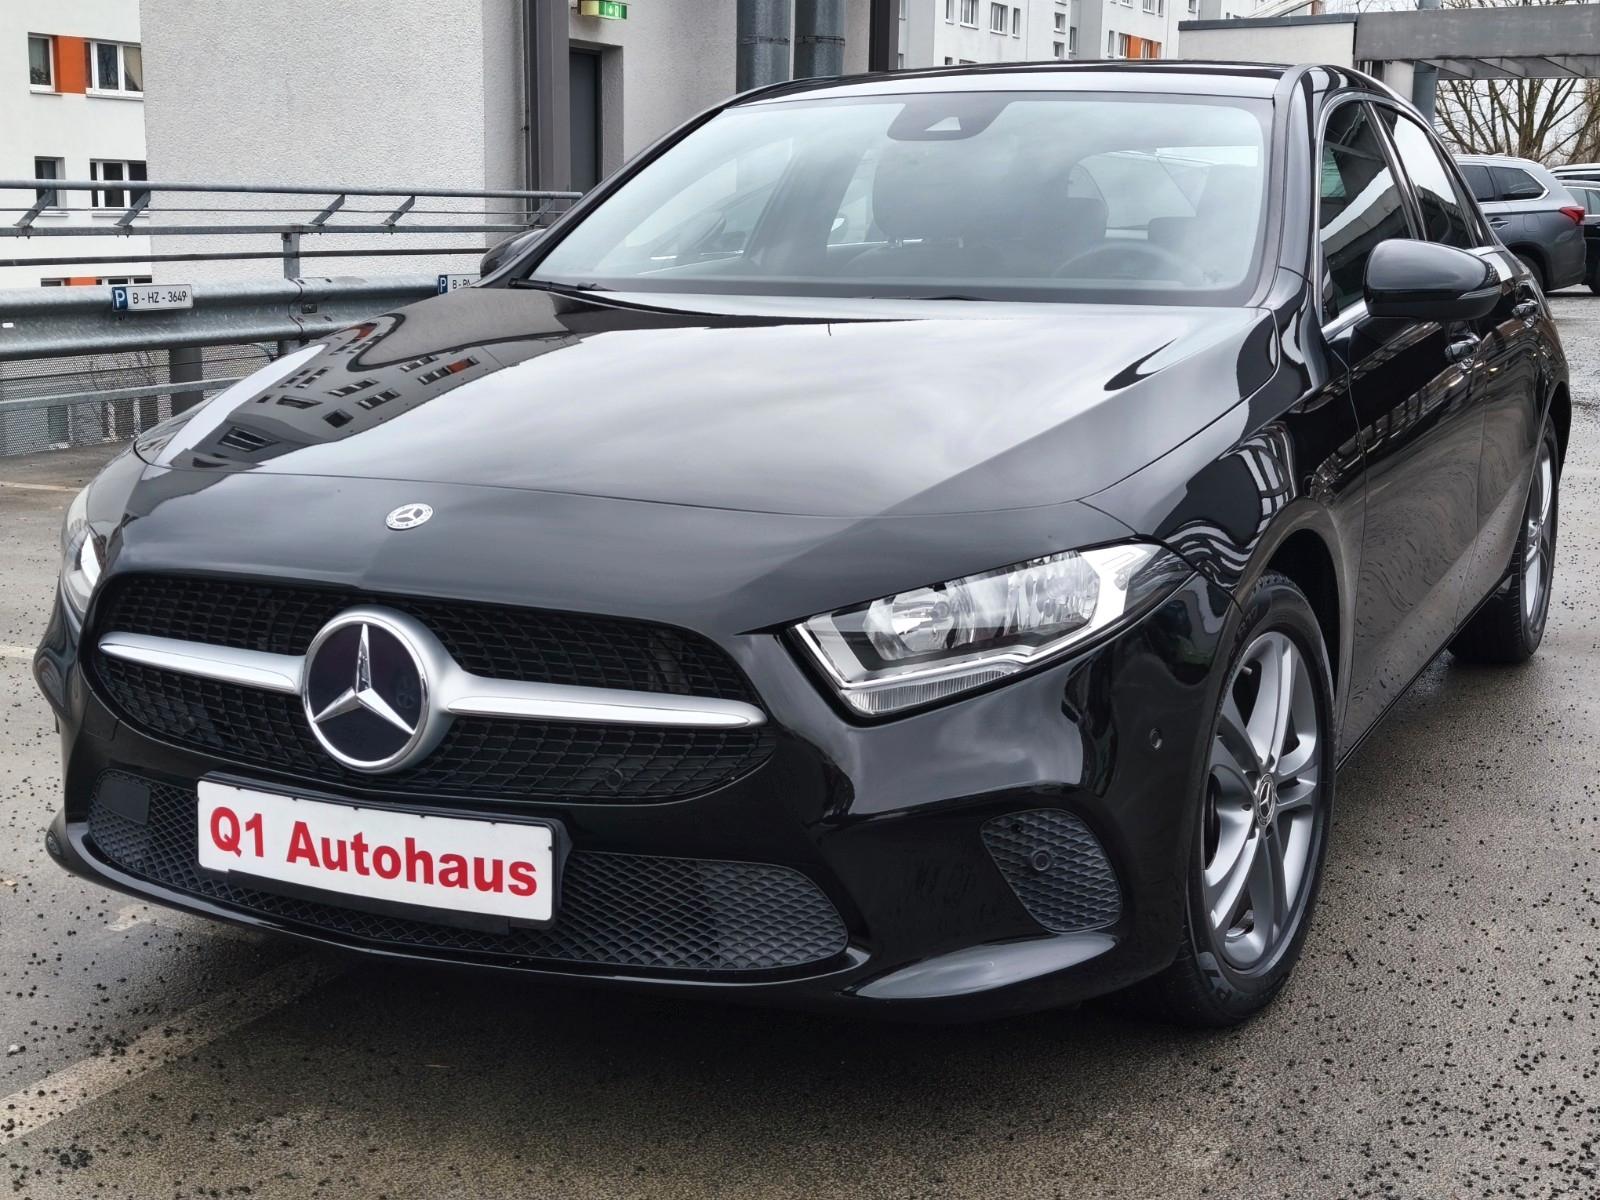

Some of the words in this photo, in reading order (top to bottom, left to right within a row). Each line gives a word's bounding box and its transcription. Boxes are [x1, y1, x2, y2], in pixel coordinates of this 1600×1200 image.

[114, 290, 126, 308] P
[209, 806, 265, 858] Q1
[286, 820, 538, 898] Autohaus
